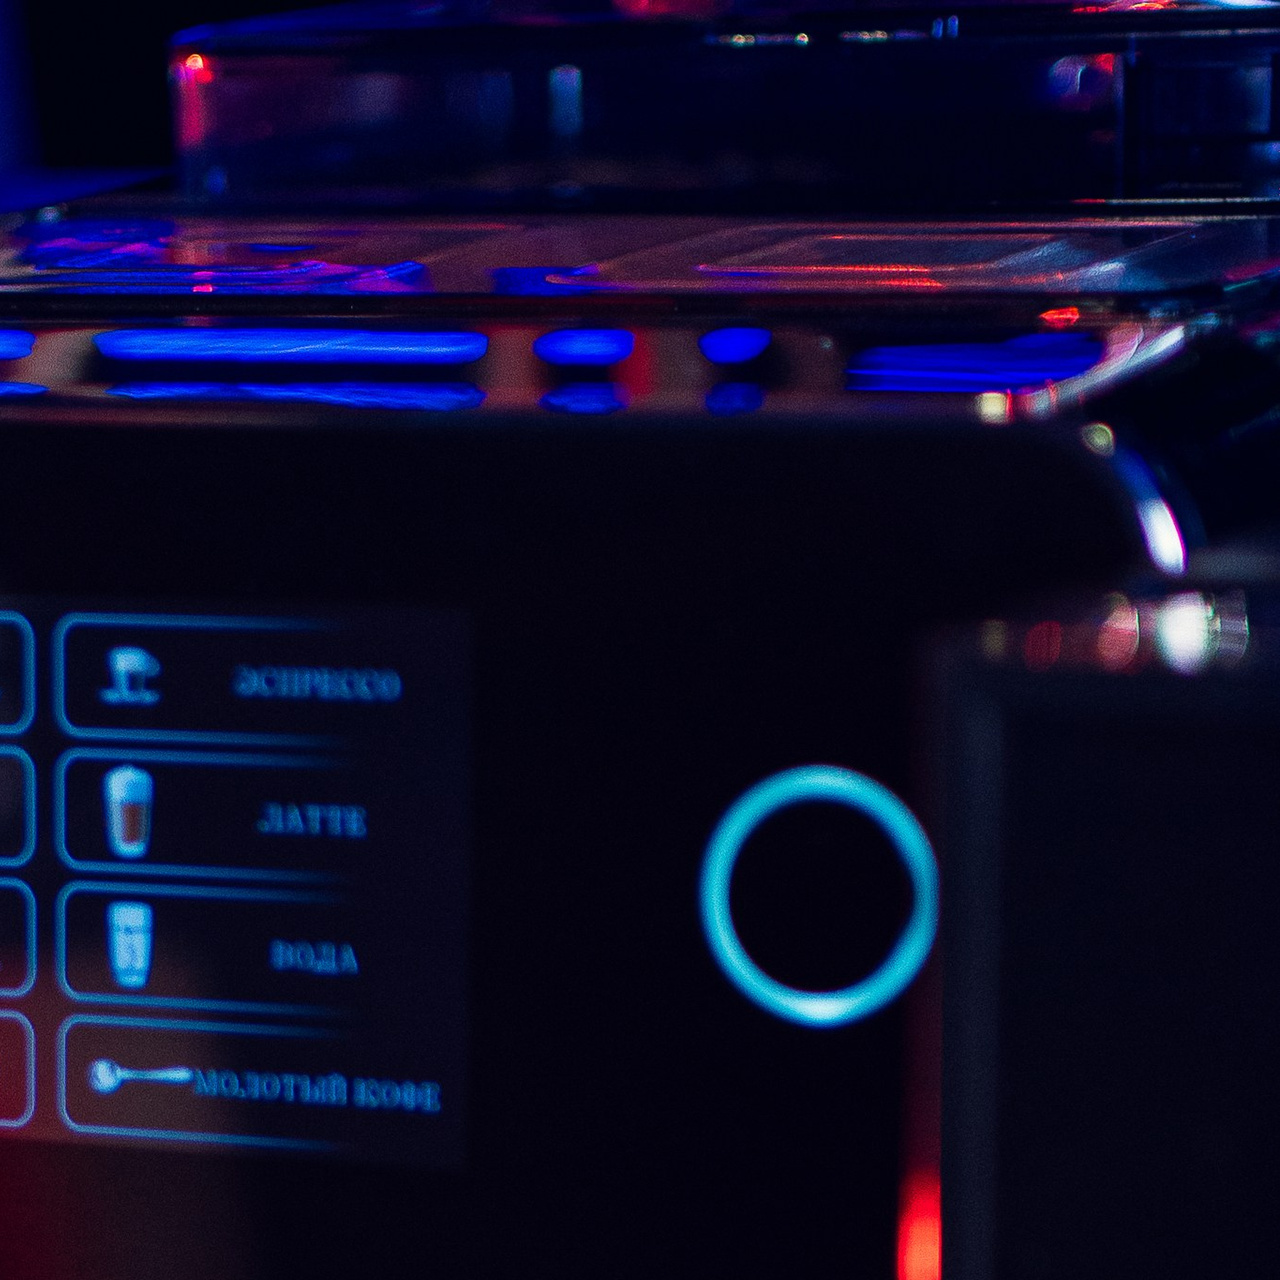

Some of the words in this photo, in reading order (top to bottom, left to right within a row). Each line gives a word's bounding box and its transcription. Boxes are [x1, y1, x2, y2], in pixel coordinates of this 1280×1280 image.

[233, 666, 403, 702] ЭСПРЕССО
[257, 802, 368, 838] ЛАТТЕ
[269, 939, 359, 974] ВОДА
[195, 1069, 348, 1106] МОЛОТЫЙ
[352, 1078, 441, 1114] КОФЕ
